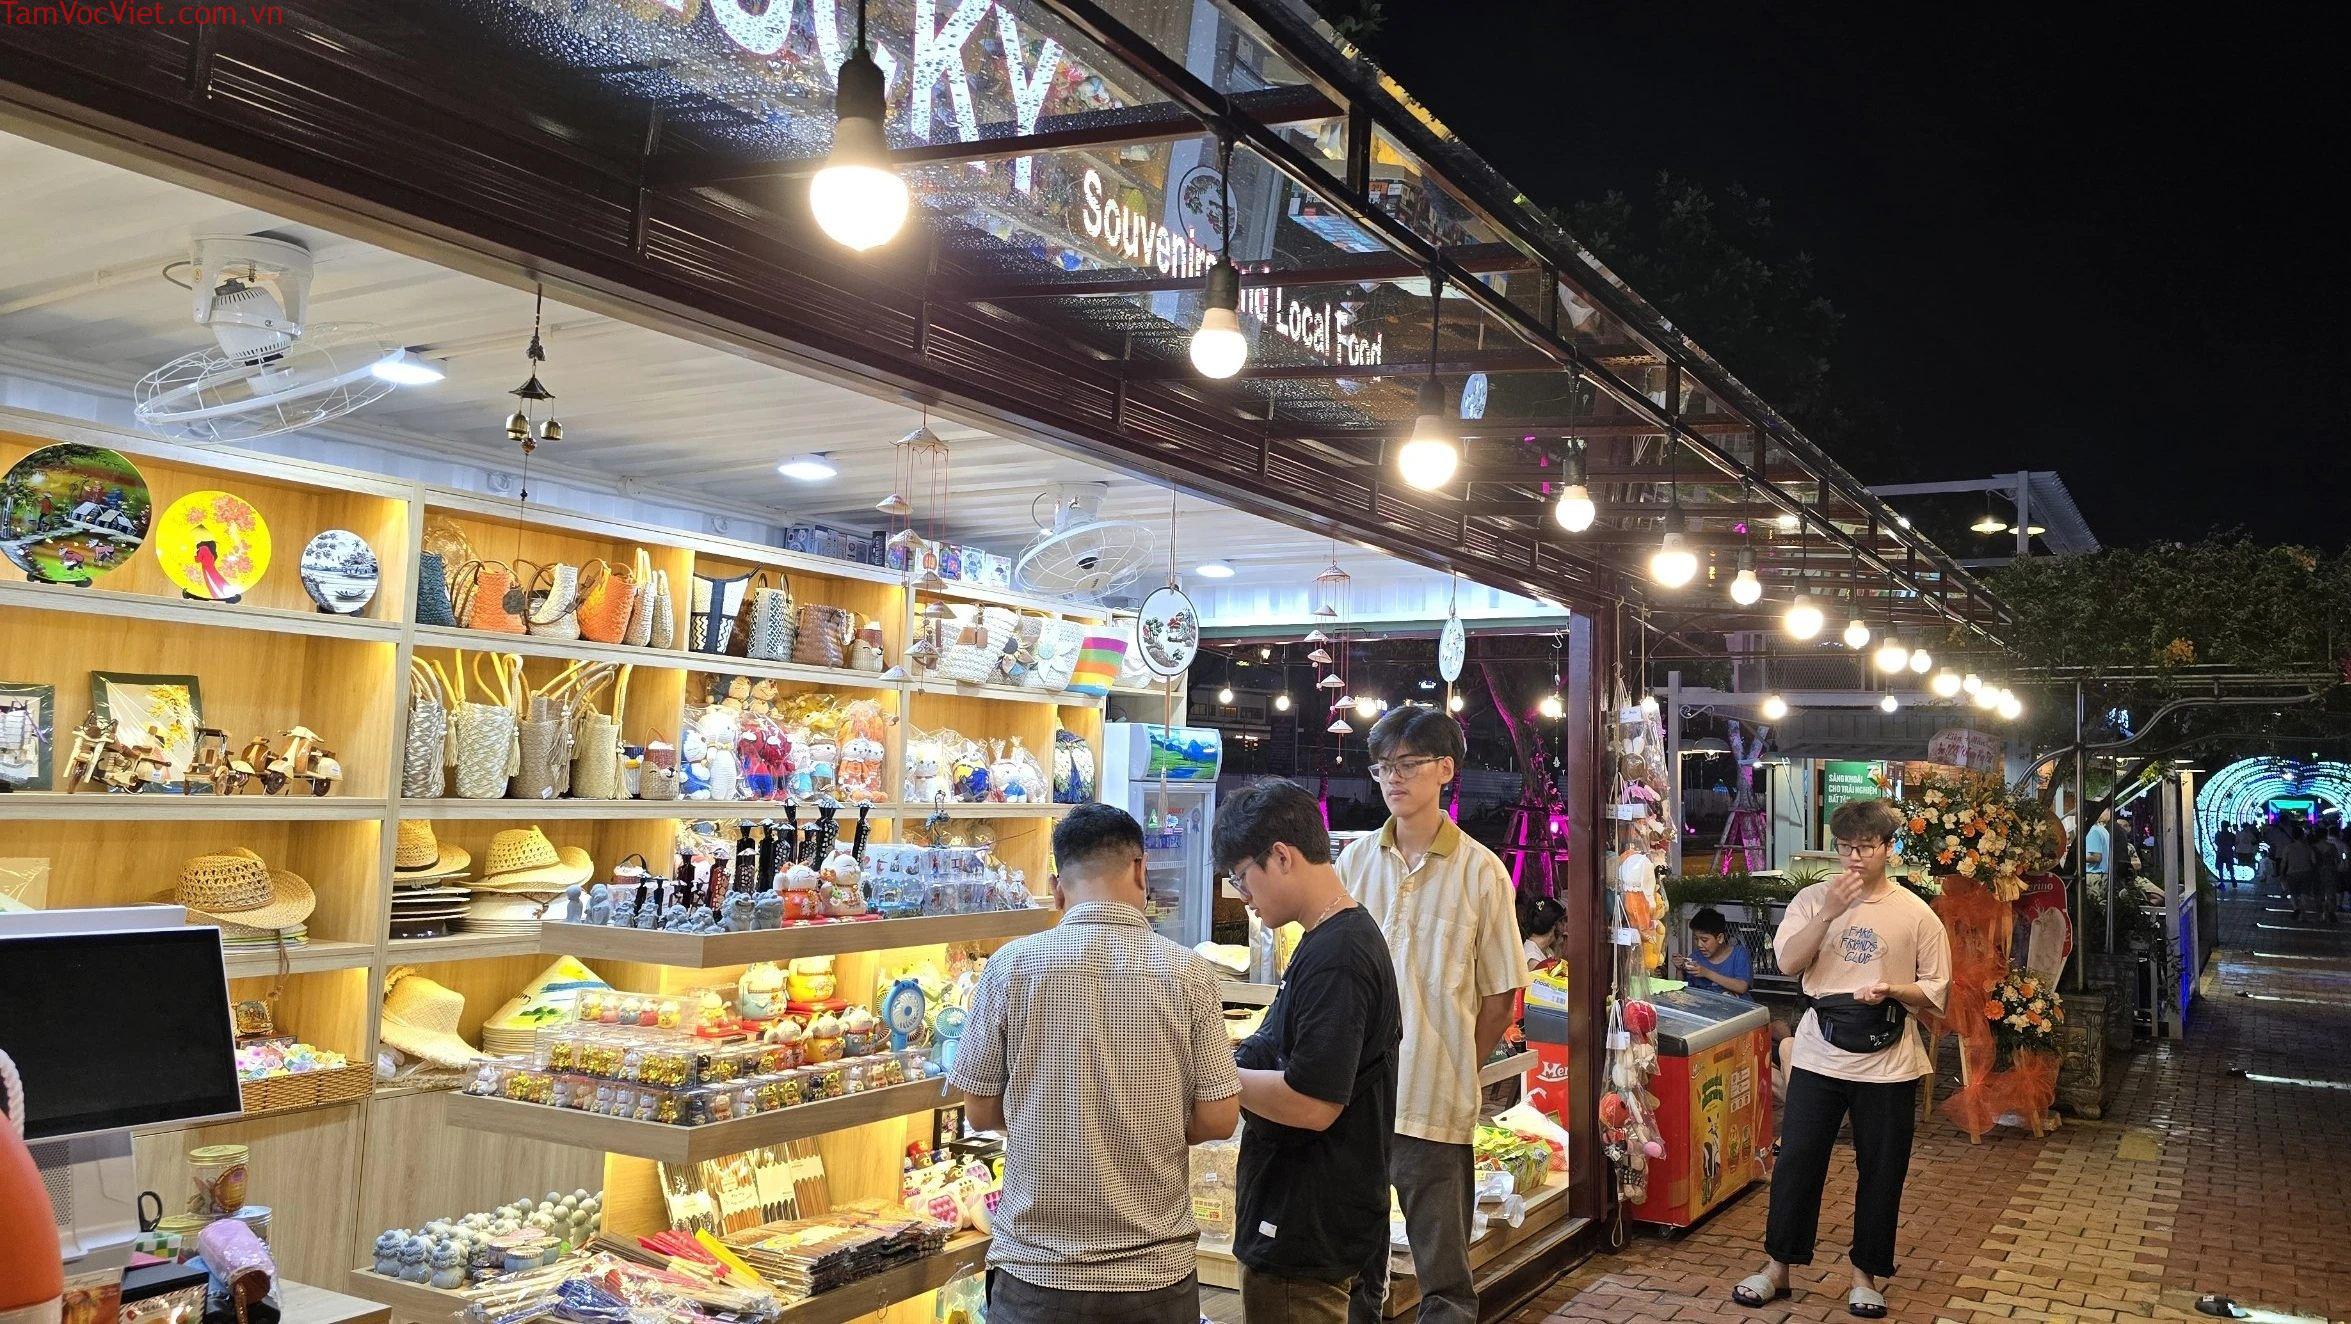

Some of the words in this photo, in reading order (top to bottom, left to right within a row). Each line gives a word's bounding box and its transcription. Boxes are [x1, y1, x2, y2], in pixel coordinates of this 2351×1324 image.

[1276, 286, 1331, 358] Local
[1828, 784, 1841, 793] CHO
[1848, 926, 1873, 938] FAKE
[1840, 937, 1878, 952] FRIENDS
[1844, 952, 1872, 964] CLUB
